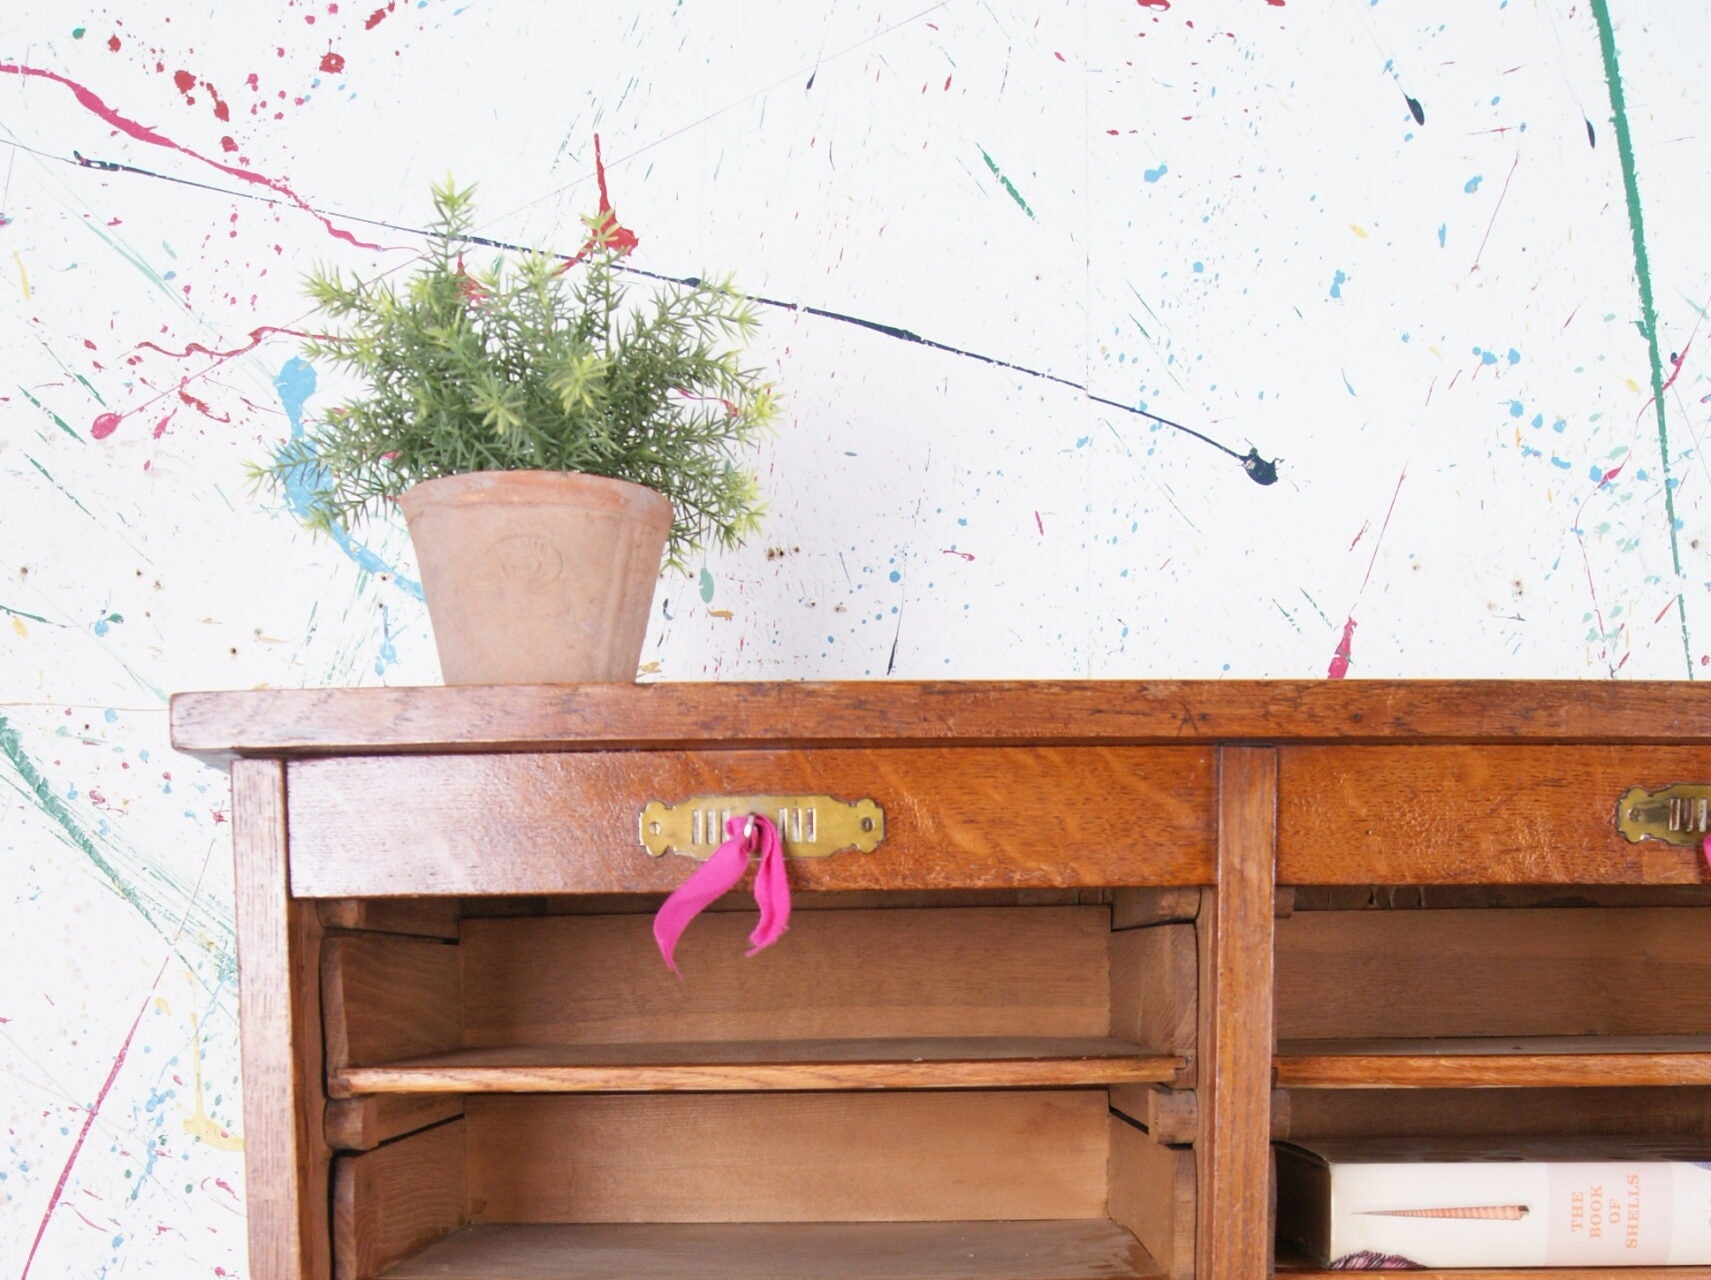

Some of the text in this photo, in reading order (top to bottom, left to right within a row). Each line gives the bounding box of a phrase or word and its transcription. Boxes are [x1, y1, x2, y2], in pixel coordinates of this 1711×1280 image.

[1571, 1191, 1583, 1232] THE
[1589, 1184, 1602, 1238] BOOK
[1608, 1198, 1621, 1224] OF
[1625, 1174, 1640, 1248] SHELLS
